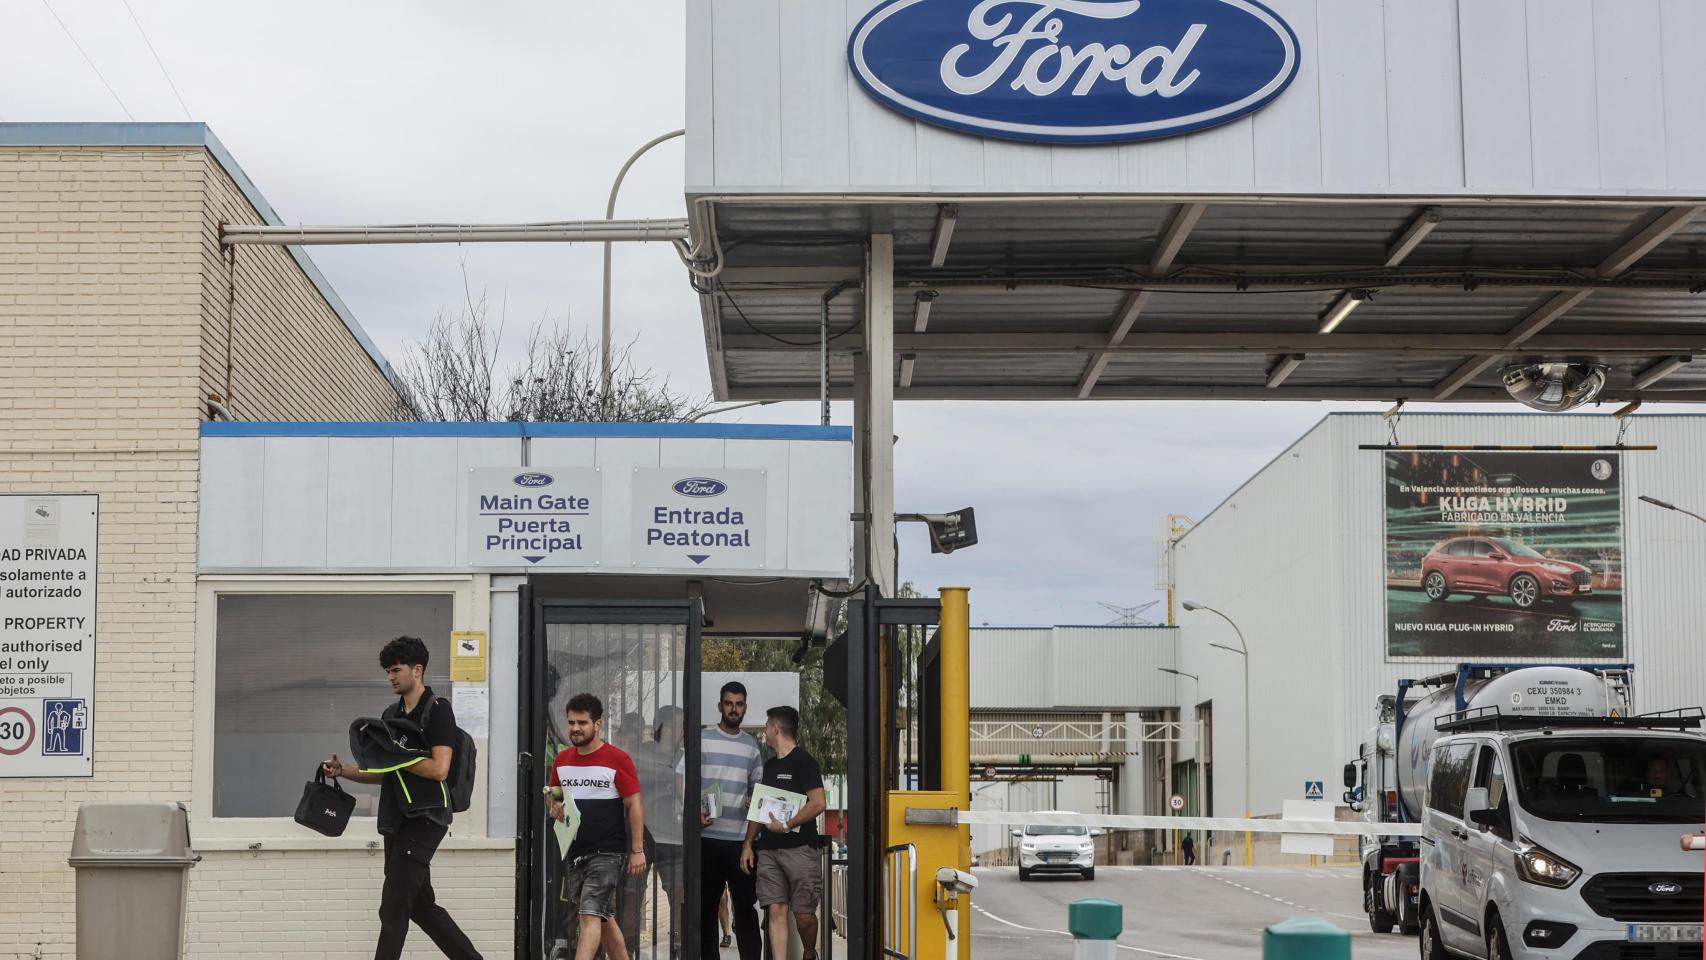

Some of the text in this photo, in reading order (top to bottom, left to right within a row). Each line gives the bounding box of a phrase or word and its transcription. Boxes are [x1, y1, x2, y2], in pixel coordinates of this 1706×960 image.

[940, 0, 1208, 97] Ford
[520, 473, 547, 486] Ford
[681, 480, 716, 495] Ford
[1498, 486, 1538, 495] orgullosos
[480, 494, 590, 510] Main Gate
[1440, 496, 1567, 512] KUGA HYBRID
[654, 507, 744, 525] Entrada
[1441, 512, 1566, 522] FABRICADO EN VALENCIA
[498, 518, 570, 533] Puerta
[647, 528, 750, 547] Peatonal
[486, 535, 582, 553] Principal
[0, 548, 87, 560] AD PRIVADA
[0, 569, 86, 581] solamente a
[6, 586, 82, 598] autorizado
[4, 617, 85, 629] PROPERTY
[1394, 623, 1423, 631] NUEVO
[1448, 623, 1482, 631] PLUG-IN
[1483, 624, 1514, 632] HYBRID
[1547, 619, 1577, 632] Ford
[1, 640, 82, 652] authorised
[17, 657, 49, 672] only
[27, 675, 65, 686] posible
[1527, 687, 1581, 695] CEXU 350984 3
[0, 722, 24, 739] 30
[561, 779, 610, 788] CK&JONES
[1656, 884, 1675, 892] Ford
